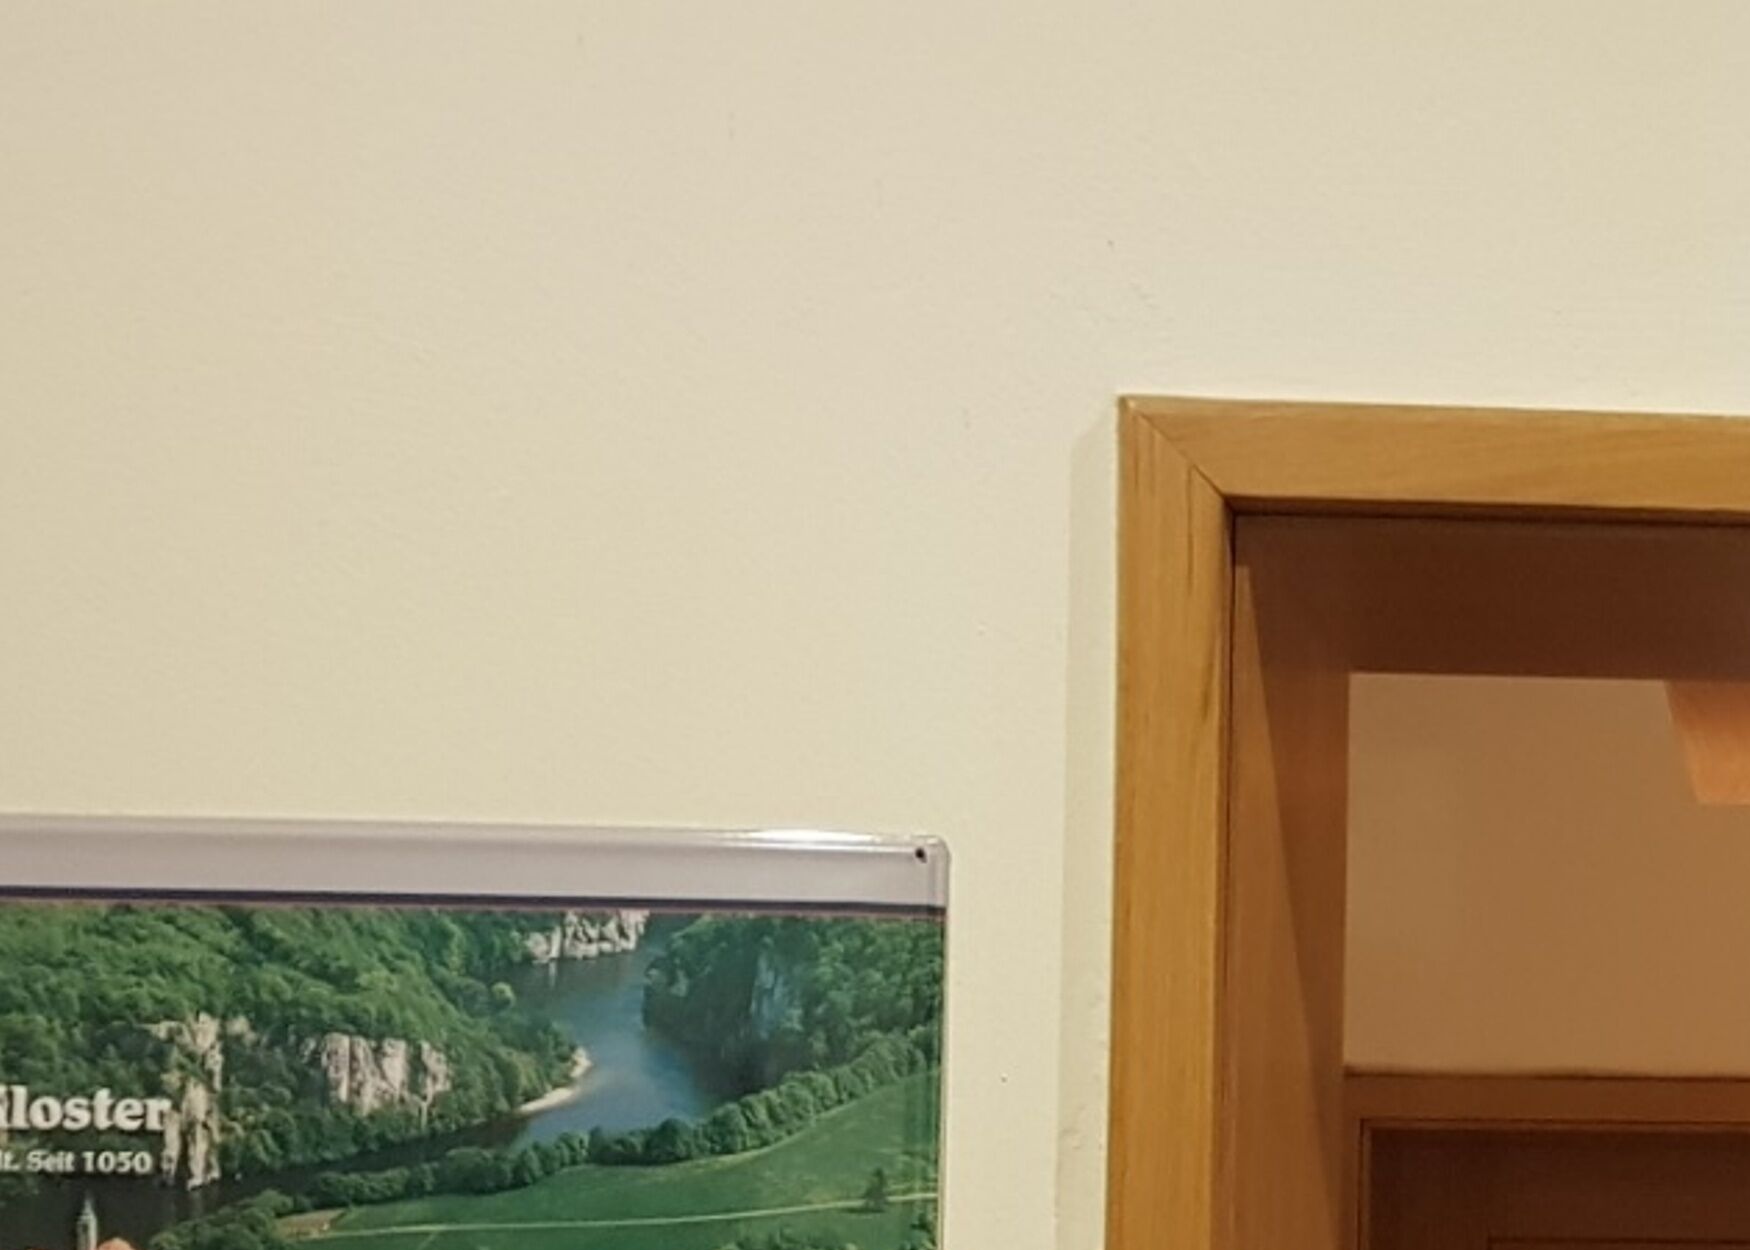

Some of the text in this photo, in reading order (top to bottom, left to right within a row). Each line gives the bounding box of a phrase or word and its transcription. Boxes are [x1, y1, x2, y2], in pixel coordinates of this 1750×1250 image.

[0, 1084, 172, 1131] loster
[27, 1150, 76, 1173] Seit
[83, 1151, 153, 1174] 1050
